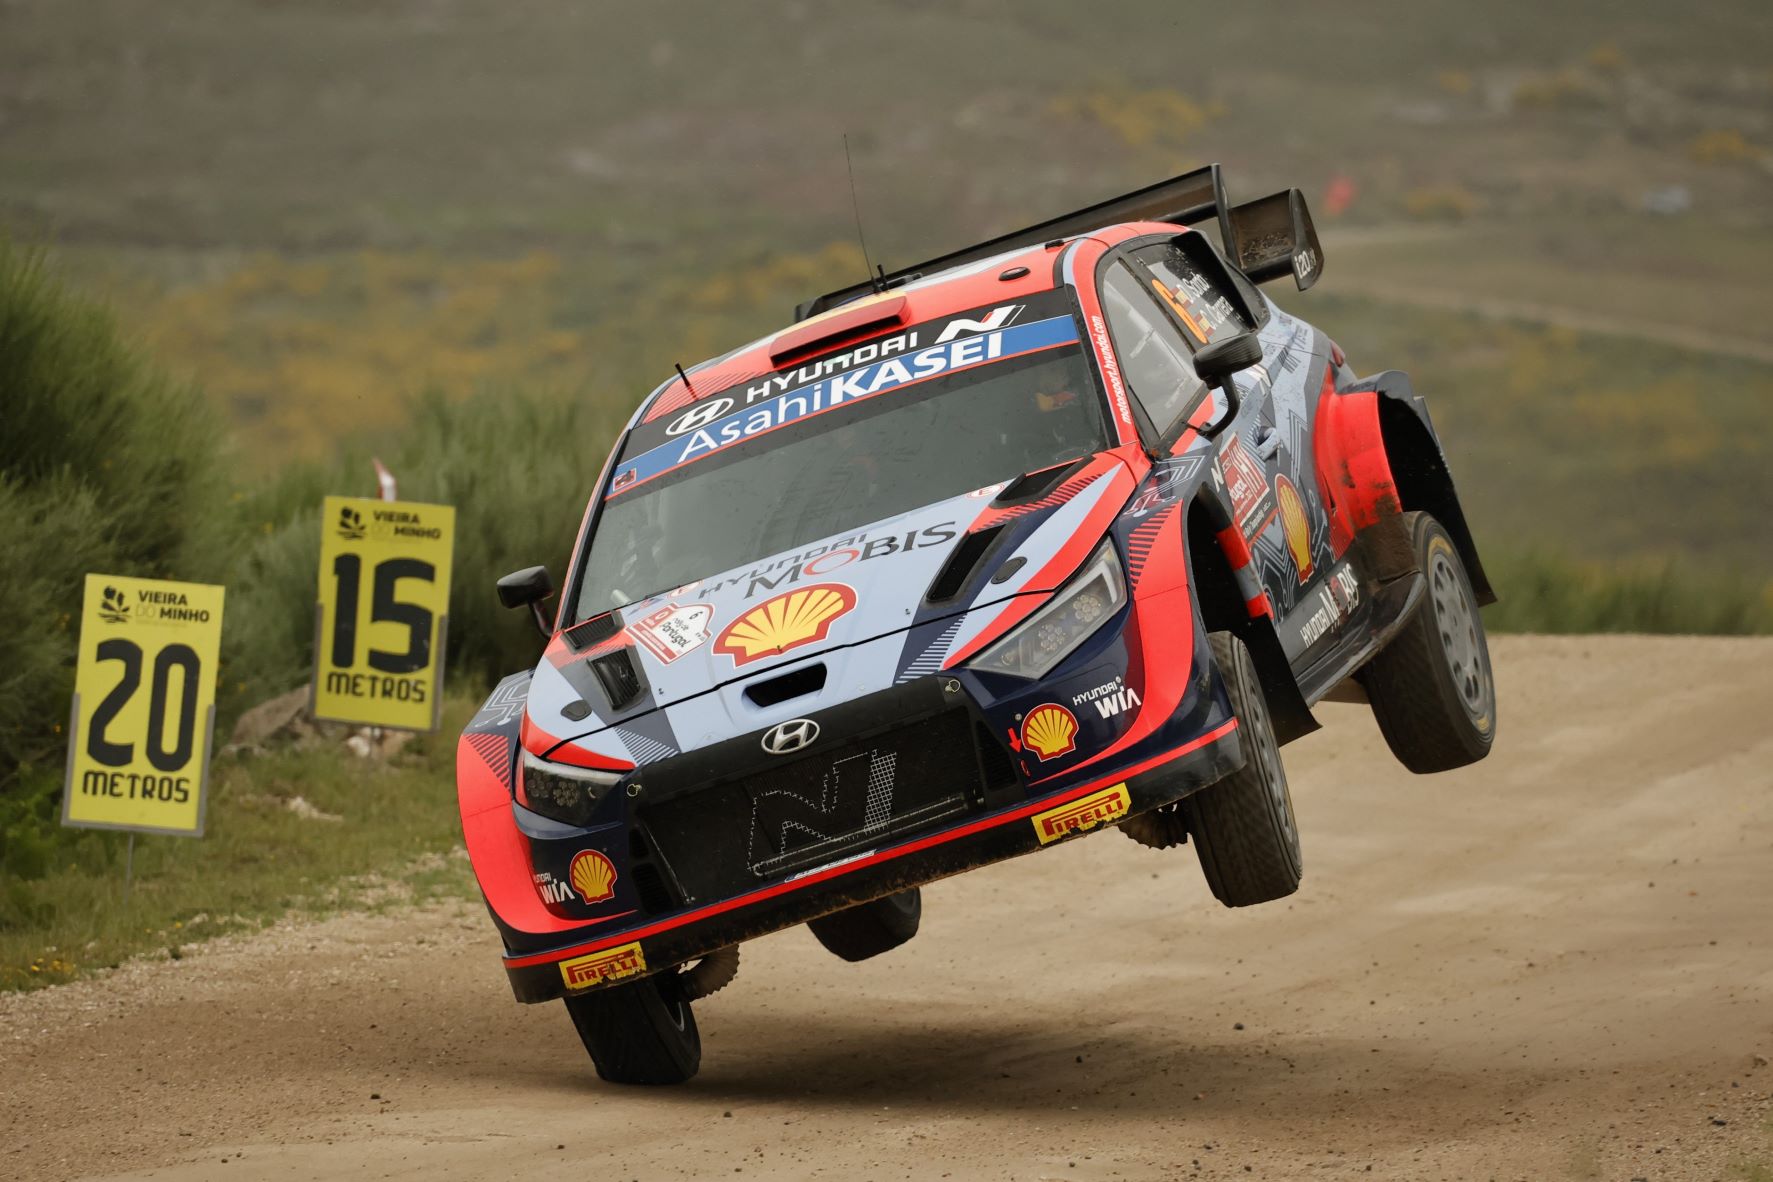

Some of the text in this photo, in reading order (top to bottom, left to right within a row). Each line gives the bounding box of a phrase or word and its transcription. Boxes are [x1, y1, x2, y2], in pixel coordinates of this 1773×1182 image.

[1294, 252, 1311, 280] i20
[747, 332, 918, 404] HYUNDAI
[1092, 315, 1132, 425] motorsport.hyundai.com
[373, 510, 421, 525] VIEIRA
[394, 526, 442, 541] MINHO
[698, 533, 868, 600] HYUNDAI
[743, 521, 957, 600] MOBIS
[138, 589, 188, 606] VIEIRA
[332, 552, 436, 674] 15
[1300, 563, 1358, 649] HYUNDAI MOBIS
[159, 607, 210, 623] MINHO
[661, 621, 692, 648] Portugal
[326, 671, 427, 704] METROS
[1072, 679, 1119, 706] HYUNDAI
[87, 637, 201, 773] 20
[82, 770, 190, 803] METROS
[1041, 790, 1125, 838] PIRELLI
[565, 950, 638, 985] PIRELLI
